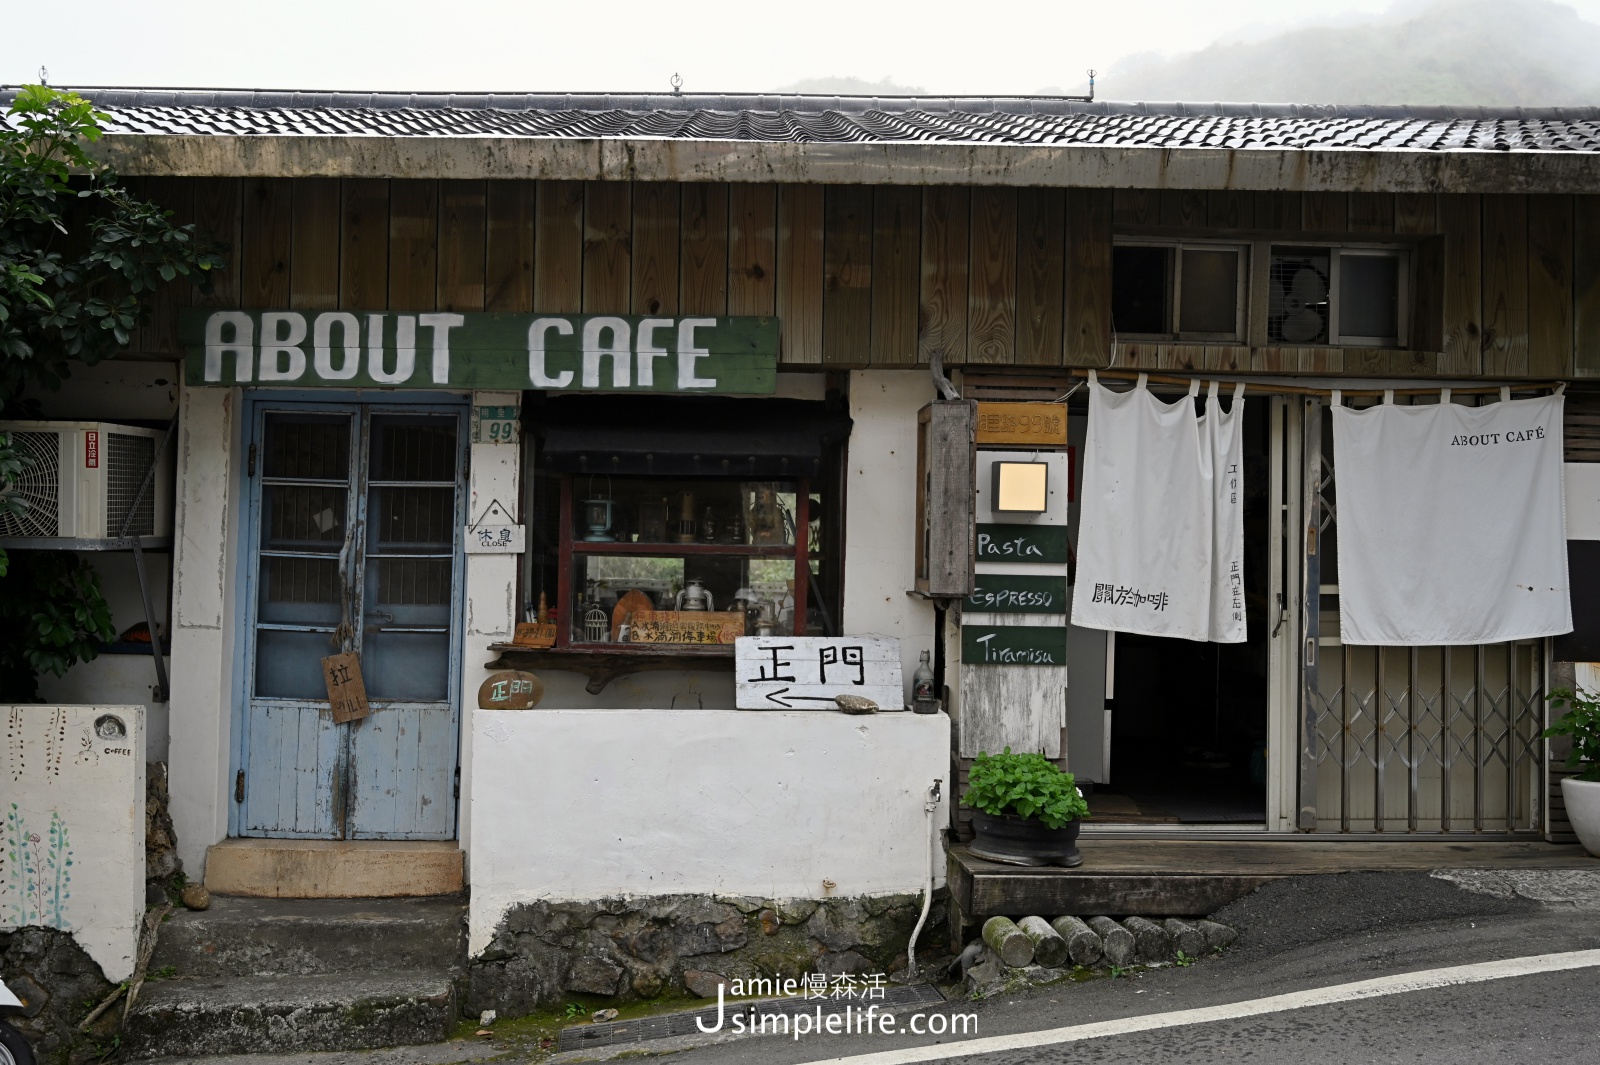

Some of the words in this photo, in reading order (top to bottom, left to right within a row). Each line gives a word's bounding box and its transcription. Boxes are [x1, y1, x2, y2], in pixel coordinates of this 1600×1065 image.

[204, 311, 465, 384] ABOUT
[528, 317, 717, 389] CAFE
[489, 421, 512, 439] 99
[1451, 433, 1500, 446] ABOUT
[1506, 426, 1545, 442] CAFÉ
[88, 433, 96, 466] 日立冷氣
[477, 528, 512, 543] 休息
[978, 533, 1043, 556] Pasta
[1092, 582, 1168, 611] 關於咖啡
[1230, 561, 1242, 622] 正門在左側
[976, 633, 1055, 663] Tiramisu
[329, 664, 352, 687] 拉
[748, 645, 865, 685] 正門
[490, 679, 533, 702] 正門
